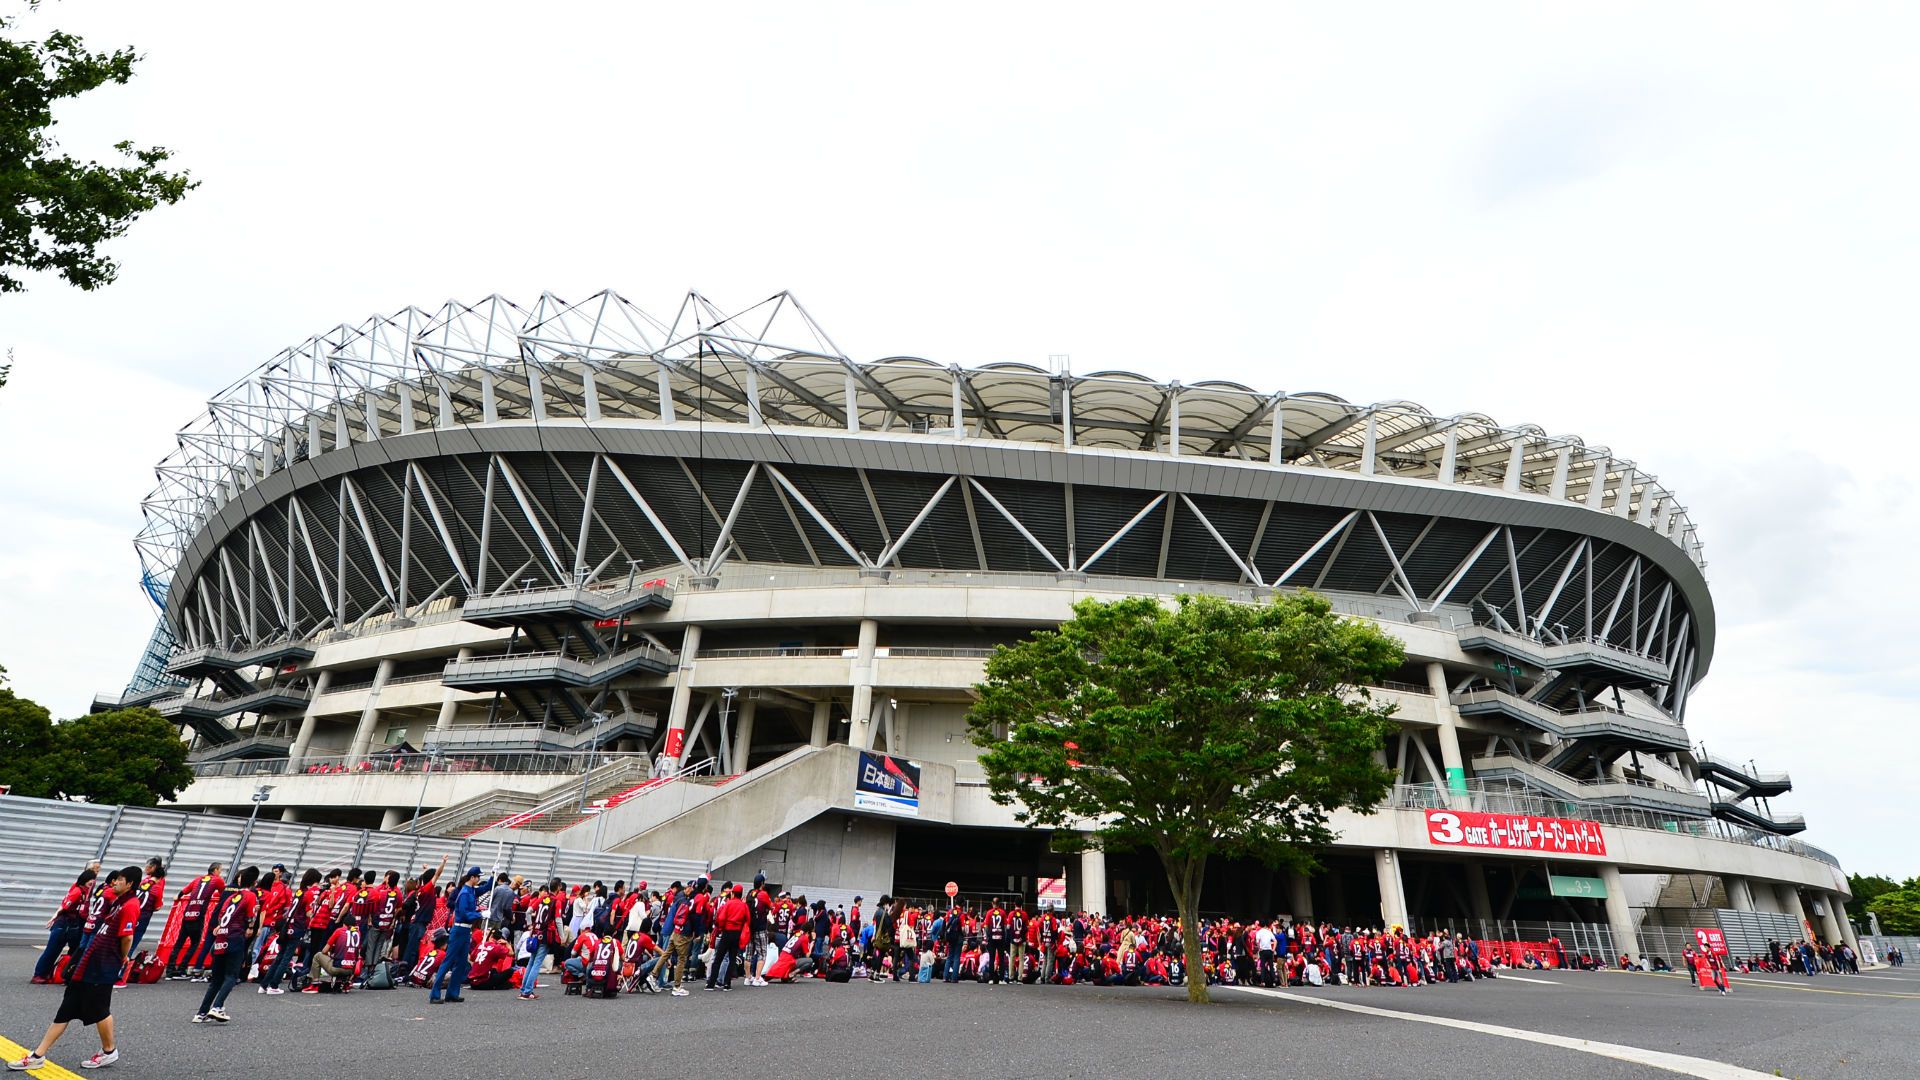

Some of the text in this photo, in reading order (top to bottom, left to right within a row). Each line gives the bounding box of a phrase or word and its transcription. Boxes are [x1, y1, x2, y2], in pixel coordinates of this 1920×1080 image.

[1429, 813, 1602, 853] 3 GATE ホームサポーターズシートゲート
[198, 882, 208, 899] 1
[1575, 880, 1583, 894] 3
[385, 898, 396, 914] 5
[221, 904, 235, 927] 8
[779, 909, 790, 922] 35
[992, 914, 1002, 929] 12
[1012, 917, 1022, 930] 10
[1043, 920, 1051, 932] 12
[345, 930, 360, 947] 10
[841, 930, 848, 942] 9
[907, 929, 914, 940] 12
[597, 943, 611, 960] 16
[1354, 943, 1362, 955] 12
[1374, 942, 1382, 952] 12
[417, 955, 435, 974] 12
[1127, 952, 1136, 964] 21
[1170, 962, 1180, 974] 16
